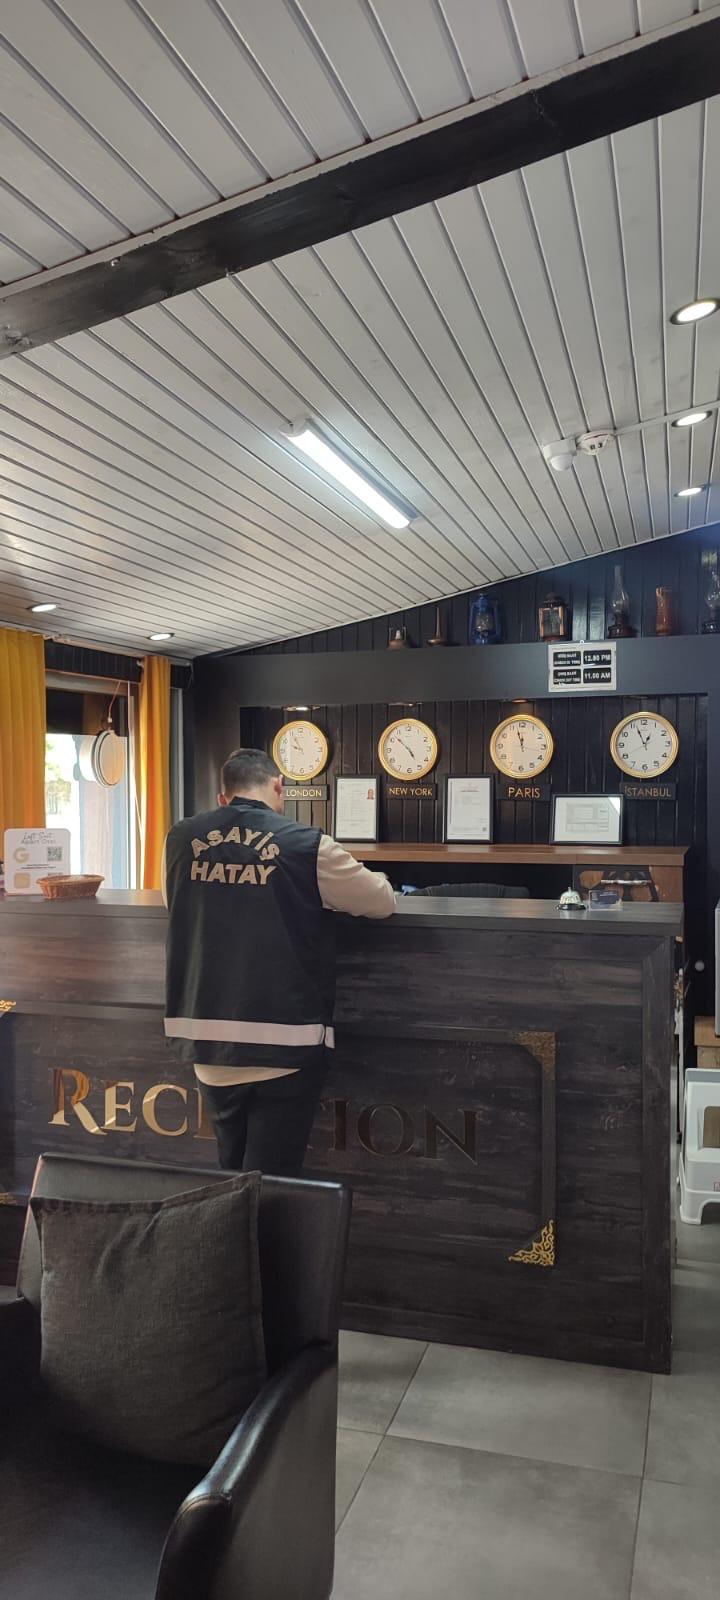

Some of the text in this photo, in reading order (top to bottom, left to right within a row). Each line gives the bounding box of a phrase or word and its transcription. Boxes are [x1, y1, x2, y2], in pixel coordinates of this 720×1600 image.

[601, 653, 611, 661] PM
[285, 787, 322, 797] LONDON
[388, 787, 433, 796] NEW YORK
[508, 786, 541, 799] PARIS
[191, 827, 280, 861] ASAYİŞ
[190, 860, 277, 885] HATAY
[47, 1067, 484, 1166] RECION
